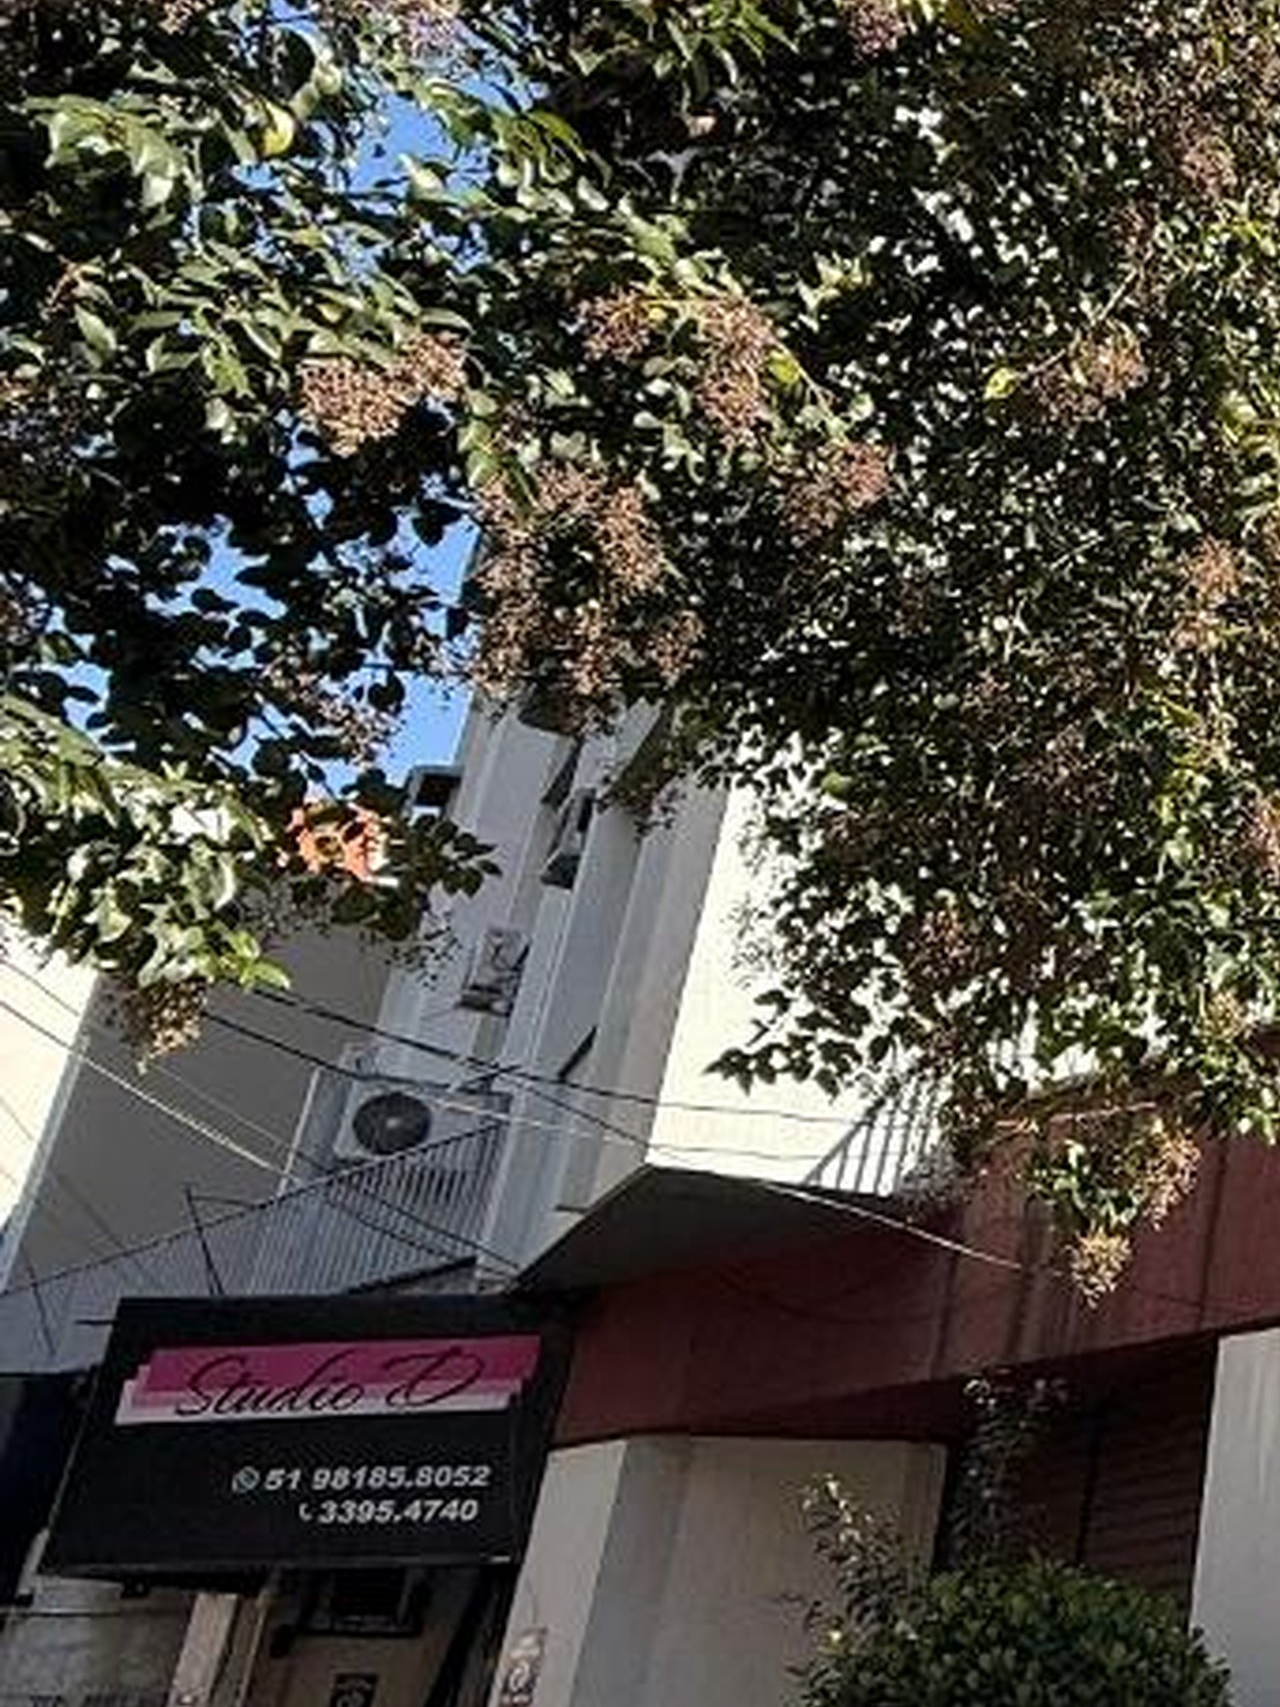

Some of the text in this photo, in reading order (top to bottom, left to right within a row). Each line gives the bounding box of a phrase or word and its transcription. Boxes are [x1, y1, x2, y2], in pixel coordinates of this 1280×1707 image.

[174, 1348, 364, 1416] Studio
[263, 1464, 492, 1491] 51 98185.8052
[317, 1497, 480, 1525] 3395.4740
